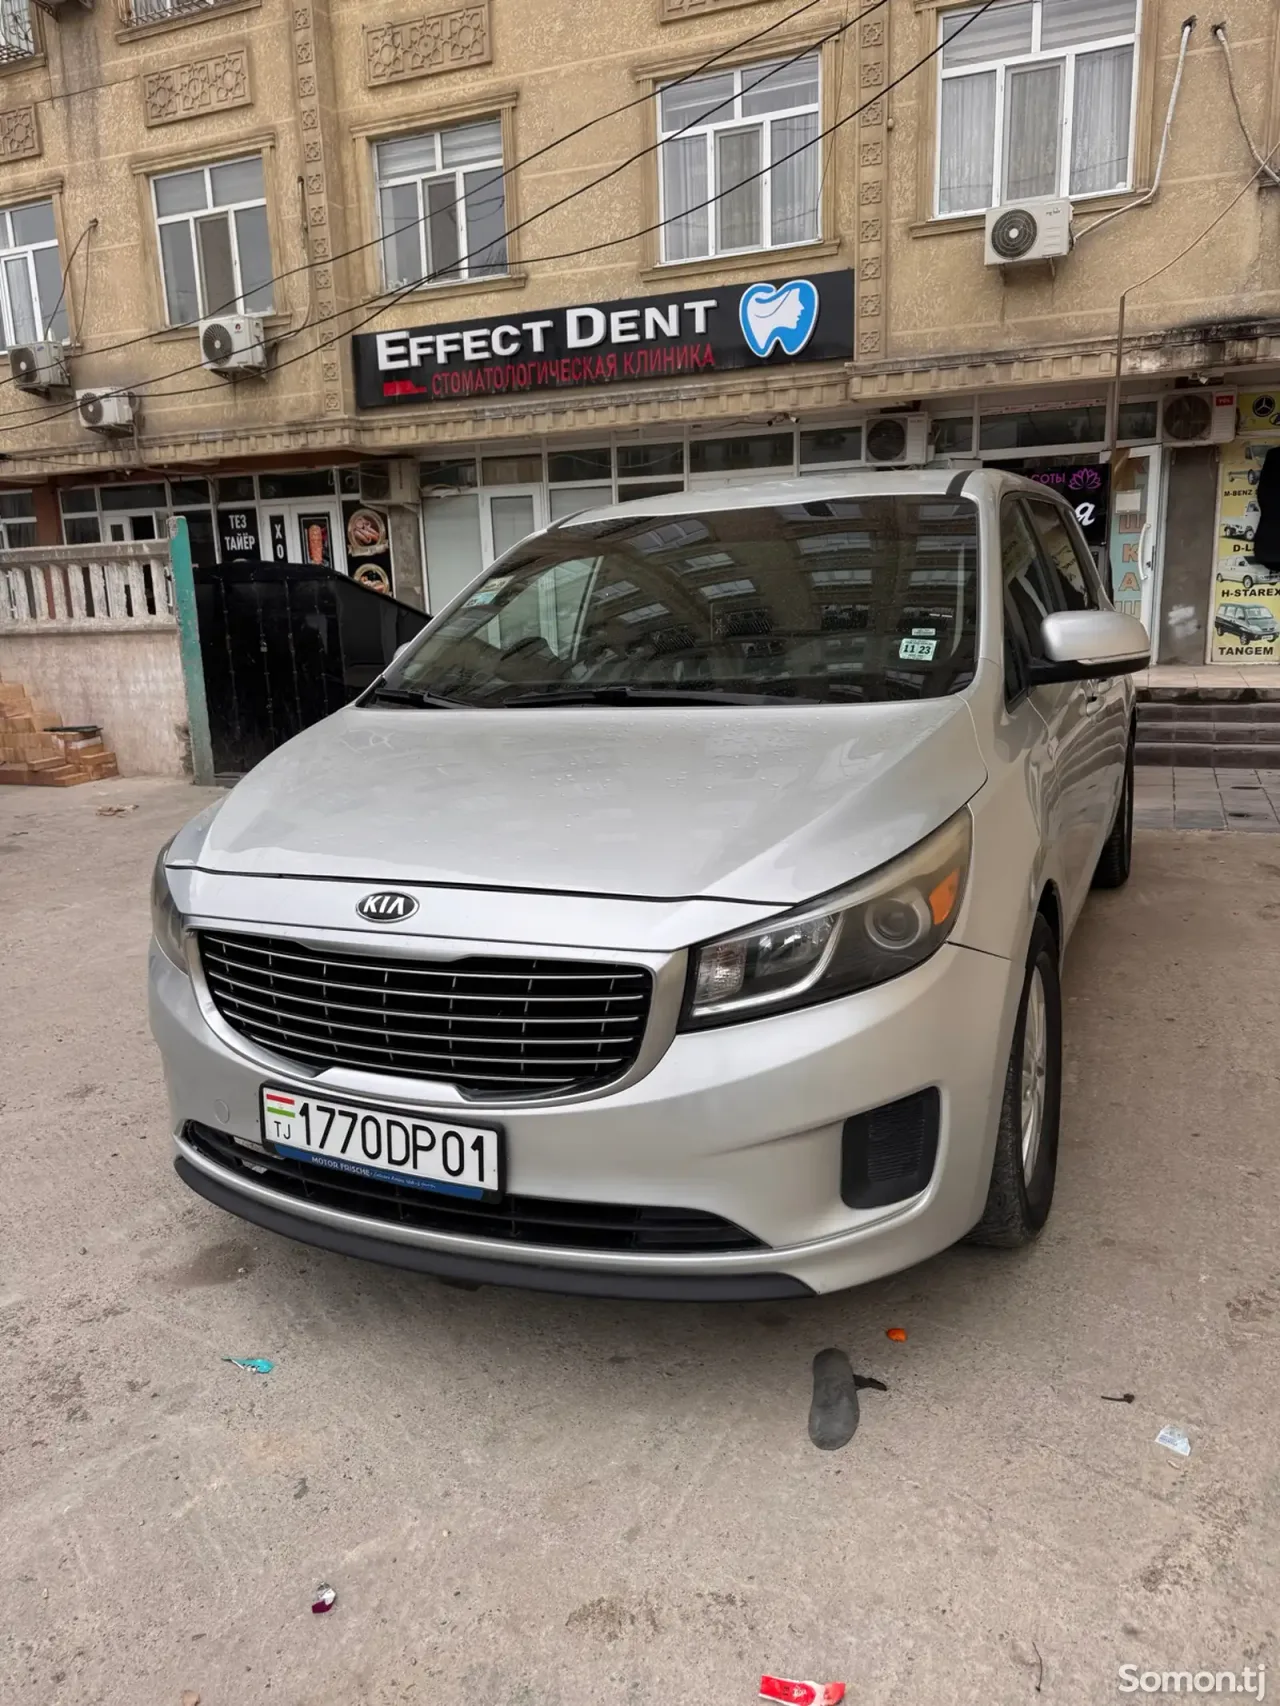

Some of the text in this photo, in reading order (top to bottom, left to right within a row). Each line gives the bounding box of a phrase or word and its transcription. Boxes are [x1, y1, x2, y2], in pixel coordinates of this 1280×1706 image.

[376, 299, 718, 371] EFFECT DENT
[432, 343, 715, 395] СТОМАТОЛОГИЧЕСКАЯ КЛИНИКА
[1029, 471, 1066, 485] СОТЫ
[1223, 489, 1253, 497] M-BENZ
[228, 514, 247, 528] ТЕЗ
[224, 533, 256, 551] ТАЙЁР
[1232, 544, 1256, 553] D-L
[904, 644, 931, 654] 11 23
[1219, 647, 1274, 656] TANGEM
[363, 895, 406, 916] KIA
[273, 1120, 292, 1141] TJ
[299, 1102, 485, 1183] 1770DP01
[311, 1156, 339, 1171] MOTOR
